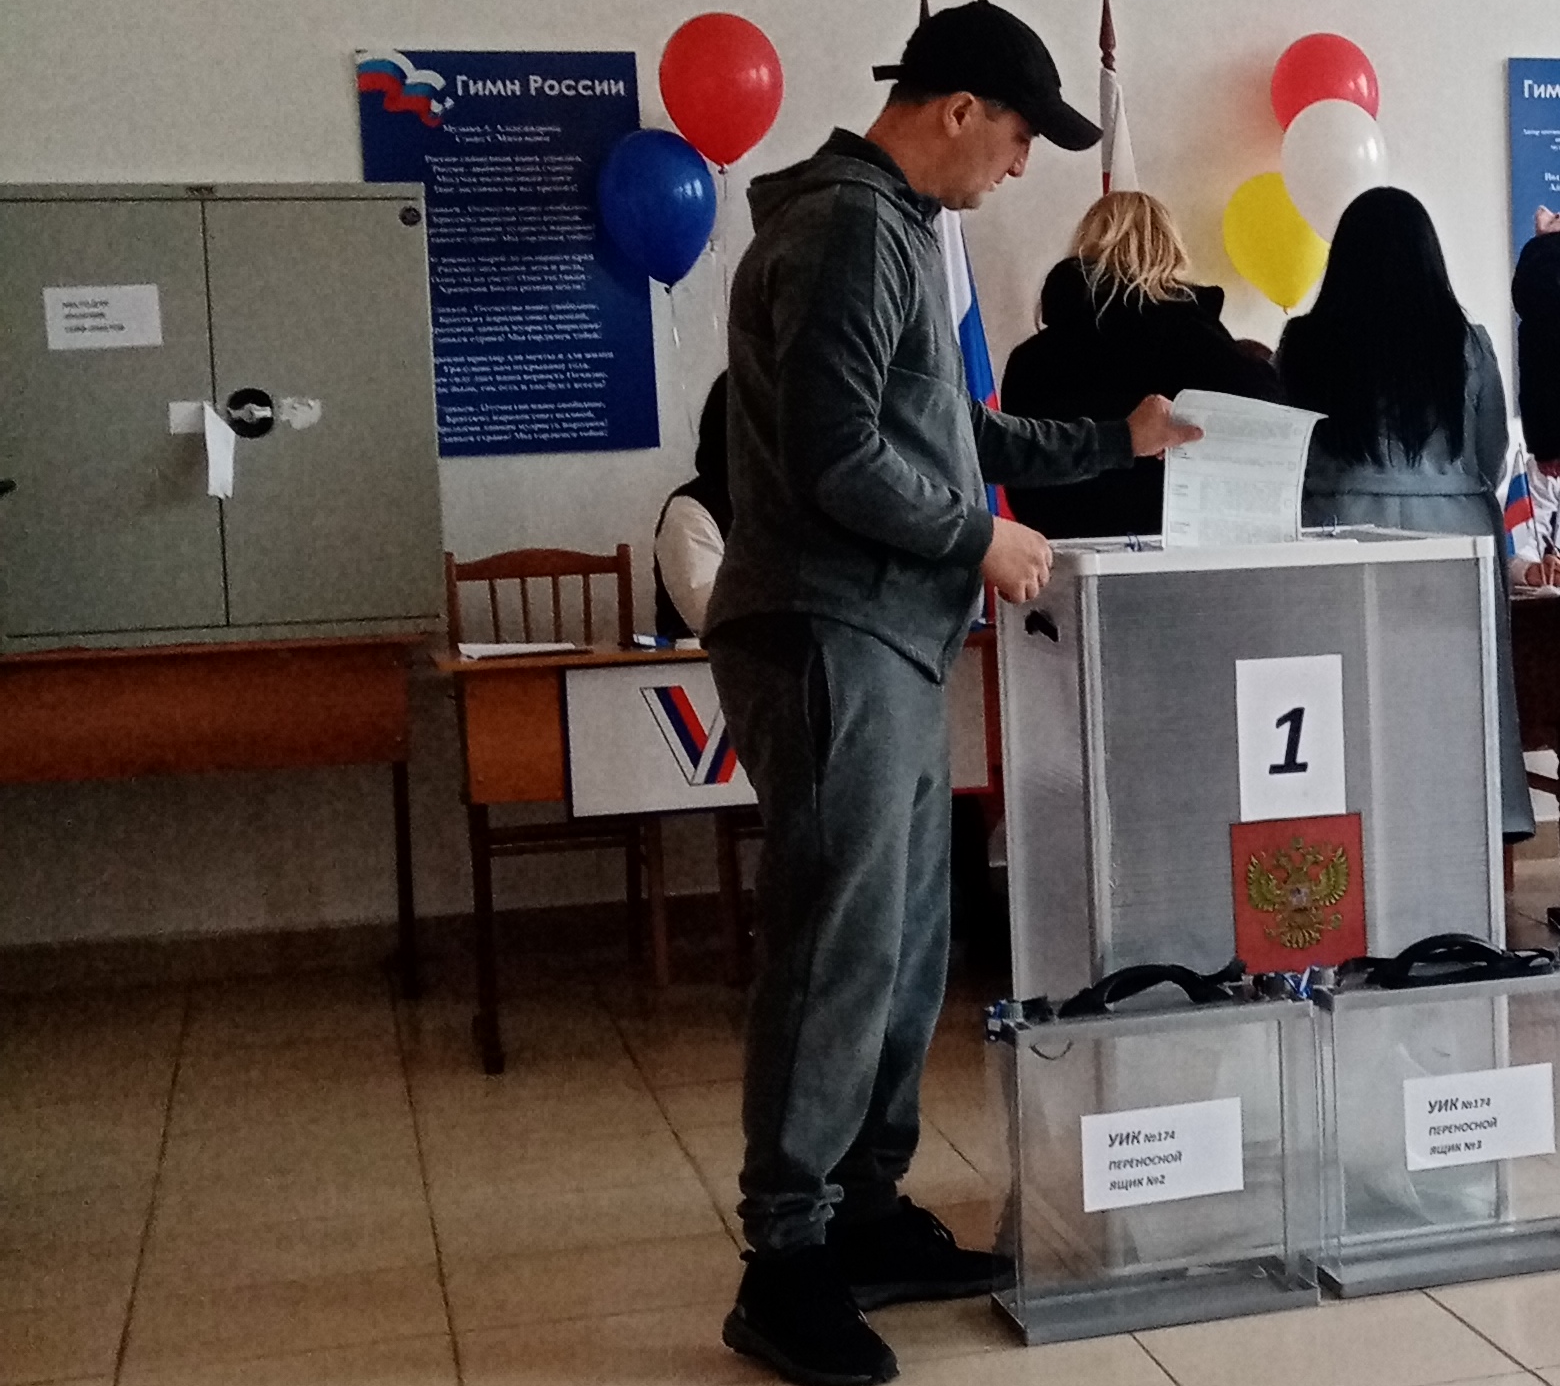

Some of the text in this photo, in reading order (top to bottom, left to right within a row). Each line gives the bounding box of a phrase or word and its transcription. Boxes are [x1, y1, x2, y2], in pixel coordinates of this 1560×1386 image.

[456, 74, 626, 97] Гимн России
[1268, 706, 1309, 775] 1
[1428, 1097, 1459, 1114] УИК
[1429, 1117, 1498, 1136] ПЕРЕНОСНОЙ
[1108, 1130, 1176, 1148] УИК №174
[1429, 1141, 1462, 1155] ЯЩИК
[1108, 1150, 1182, 1171] ПЕРЕНОСНОЙ
[1109, 1174, 1166, 1191] ЯЩИК №2
